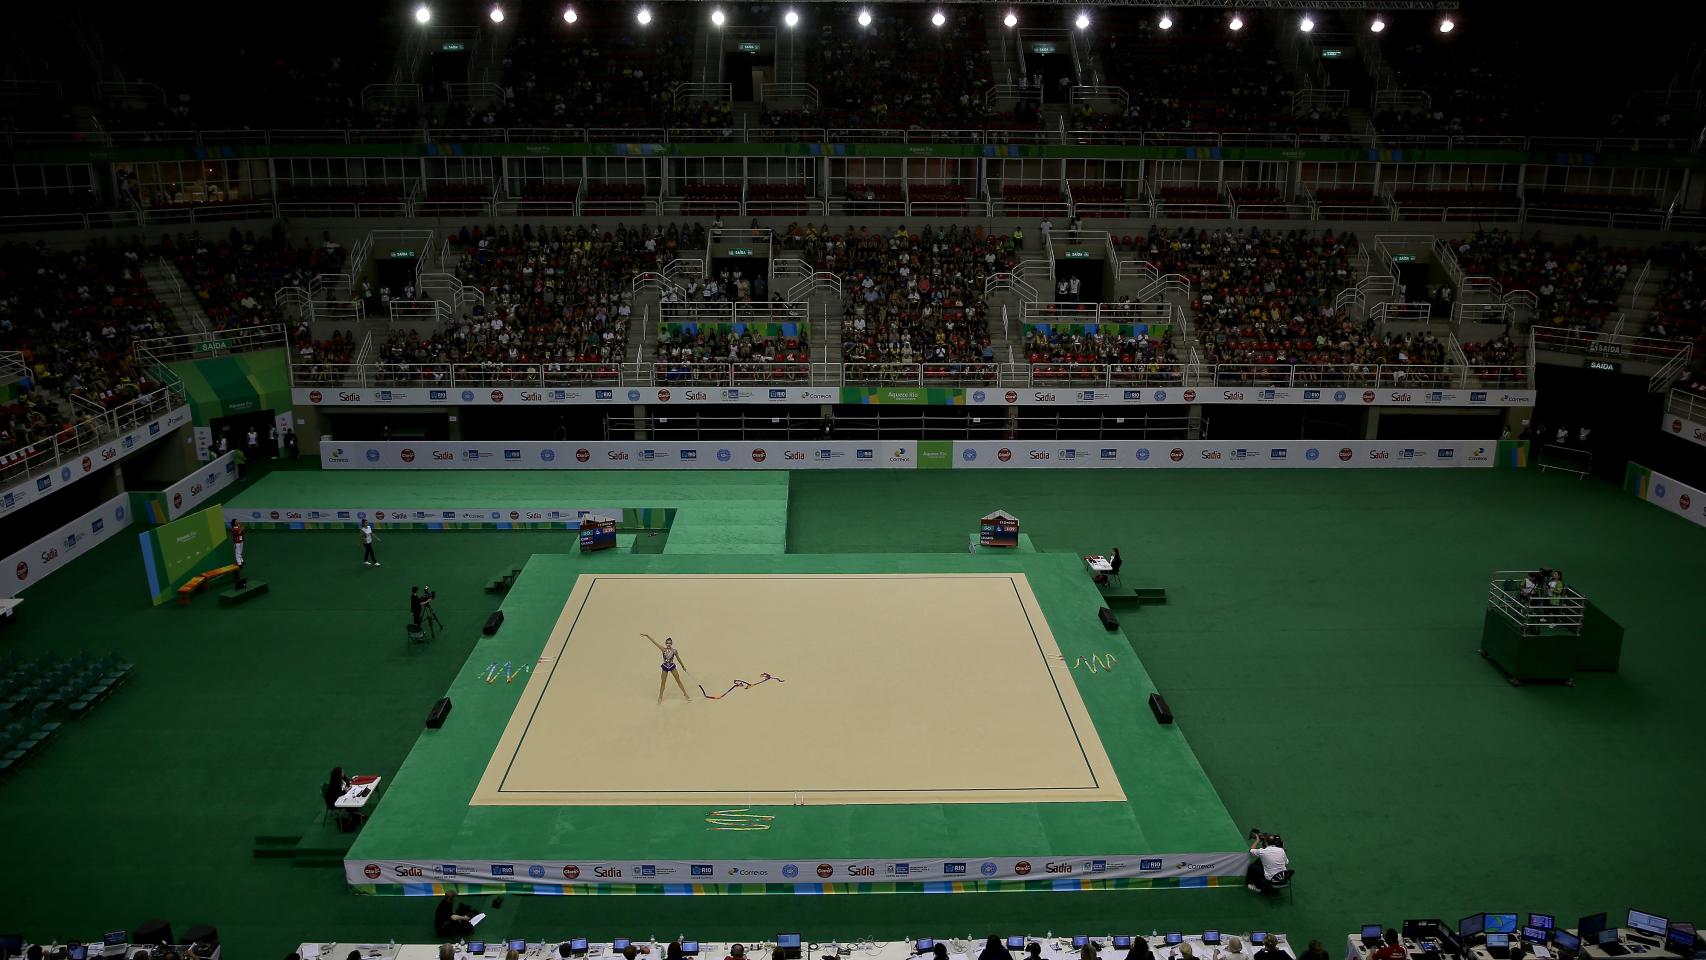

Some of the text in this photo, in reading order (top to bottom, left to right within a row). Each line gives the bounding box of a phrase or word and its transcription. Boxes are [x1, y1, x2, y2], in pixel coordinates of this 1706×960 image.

[339, 392, 360, 401] Sadia
[520, 392, 541, 401] Sadia
[686, 391, 706, 401] Sadia
[1035, 392, 1056, 401] Sadia
[1223, 391, 1244, 400] Sadia
[1391, 392, 1411, 402] Sadia
[433, 451, 453, 460] Sadia
[608, 450, 628, 460] Sadia
[784, 450, 804, 460] Sadia
[1030, 450, 1050, 460] Sadia
[1202, 450, 1221, 460] Sadia
[1370, 450, 1389, 459] Sadia
[394, 866, 422, 877] Sadia
[594, 867, 621, 877] Sadia
[848, 865, 874, 876] Sadia
[1045, 862, 1072, 873] Sadia
